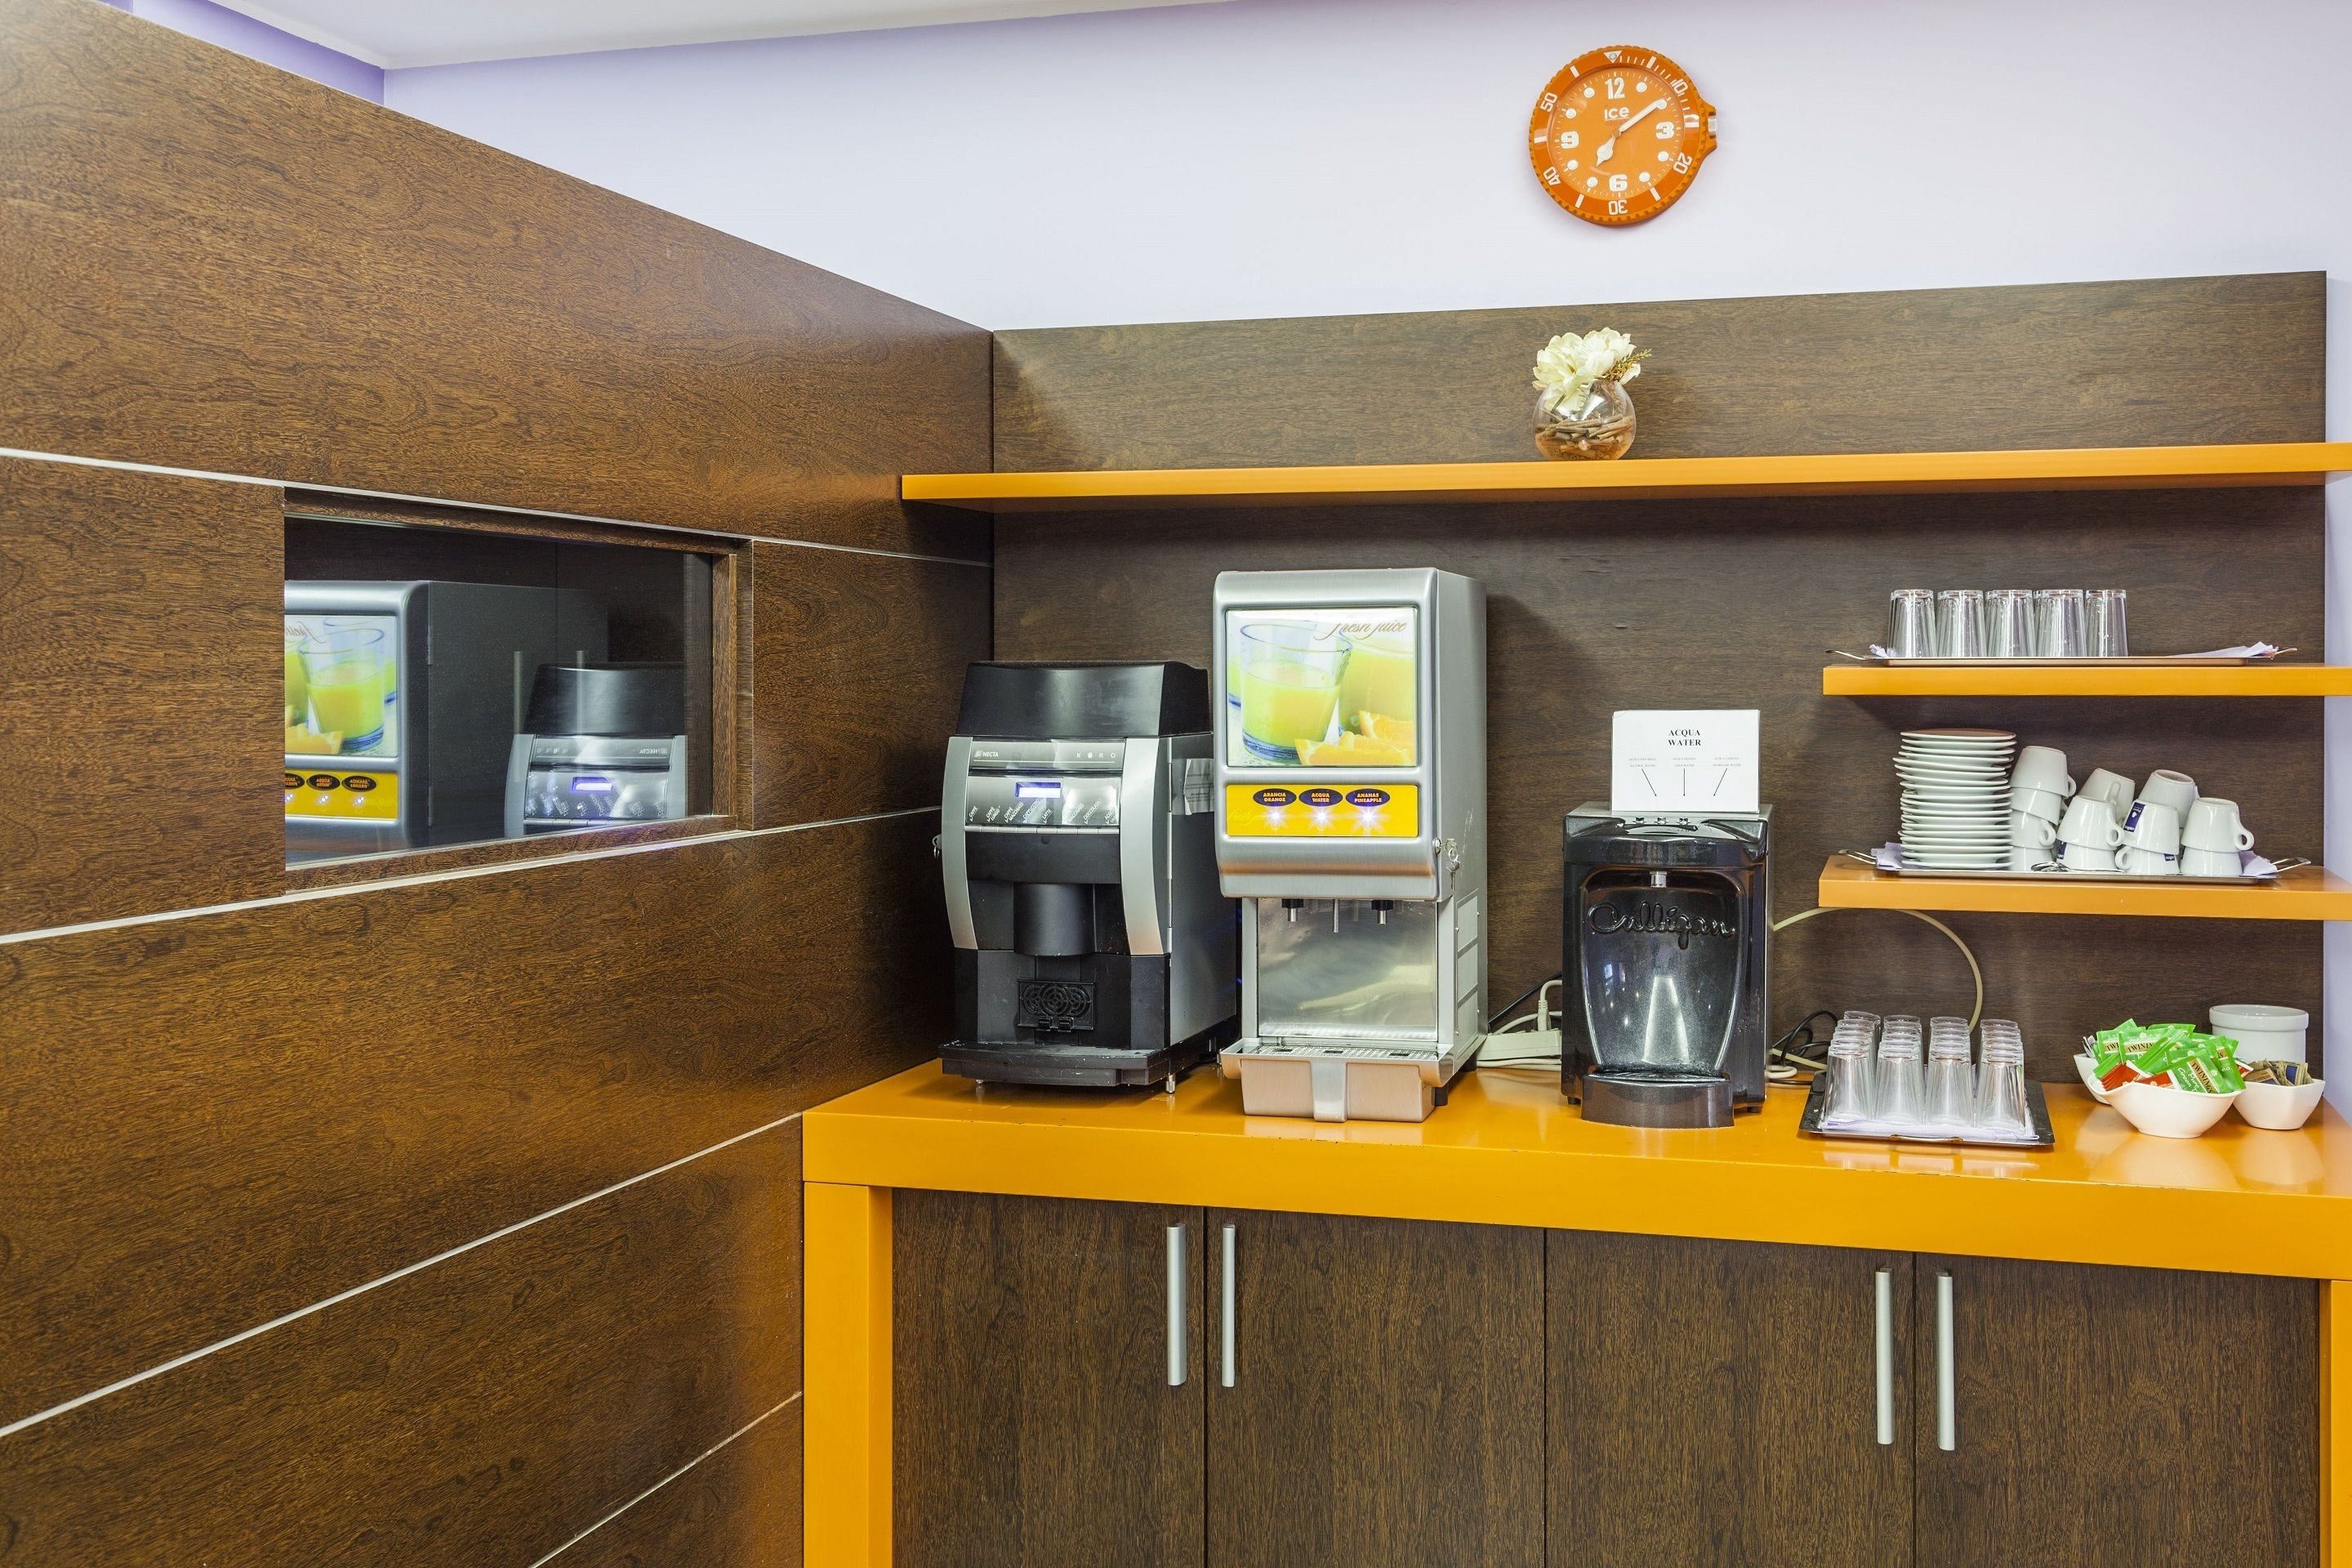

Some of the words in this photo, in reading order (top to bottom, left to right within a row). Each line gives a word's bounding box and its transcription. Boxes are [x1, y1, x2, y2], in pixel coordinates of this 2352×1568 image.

[1605, 77, 1625, 100] 12
[1671, 78, 1689, 96] 10
[1540, 92, 1558, 112] 50
[1561, 131, 1579, 149] 9
[1655, 121, 1675, 140] 3
[1673, 152, 1693, 175] 20
[1543, 166, 1561, 186] 40
[1609, 174, 1628, 192] 6
[1608, 199, 1628, 216] 30
[1668, 728, 1700, 737] ACQUA
[1588, 901, 1735, 950] Culligan
[2177, 1067, 2192, 1087] Green
